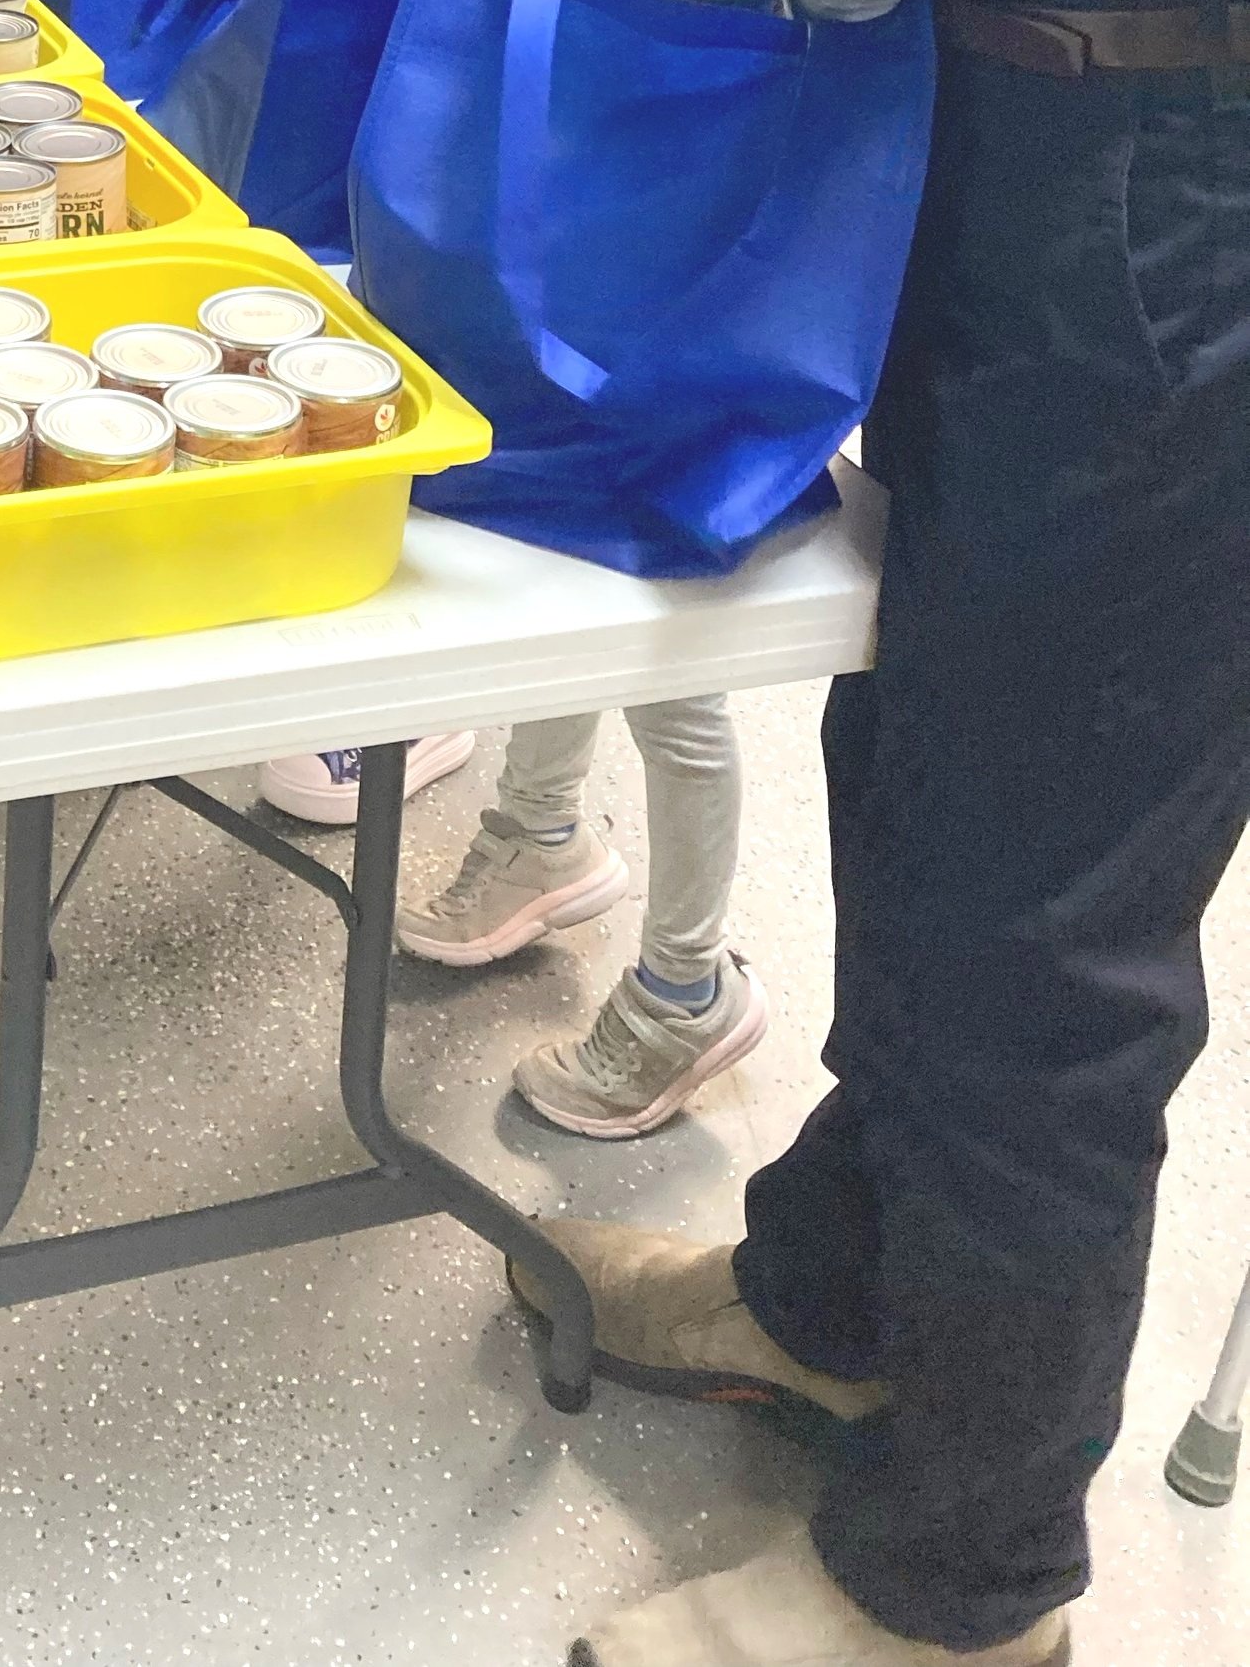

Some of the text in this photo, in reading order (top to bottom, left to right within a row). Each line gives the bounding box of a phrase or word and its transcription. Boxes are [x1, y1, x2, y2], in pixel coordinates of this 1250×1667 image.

[74, 188, 104, 200] kernel
[16, 200, 40, 211] Facts
[28, 228, 40, 239] 70
